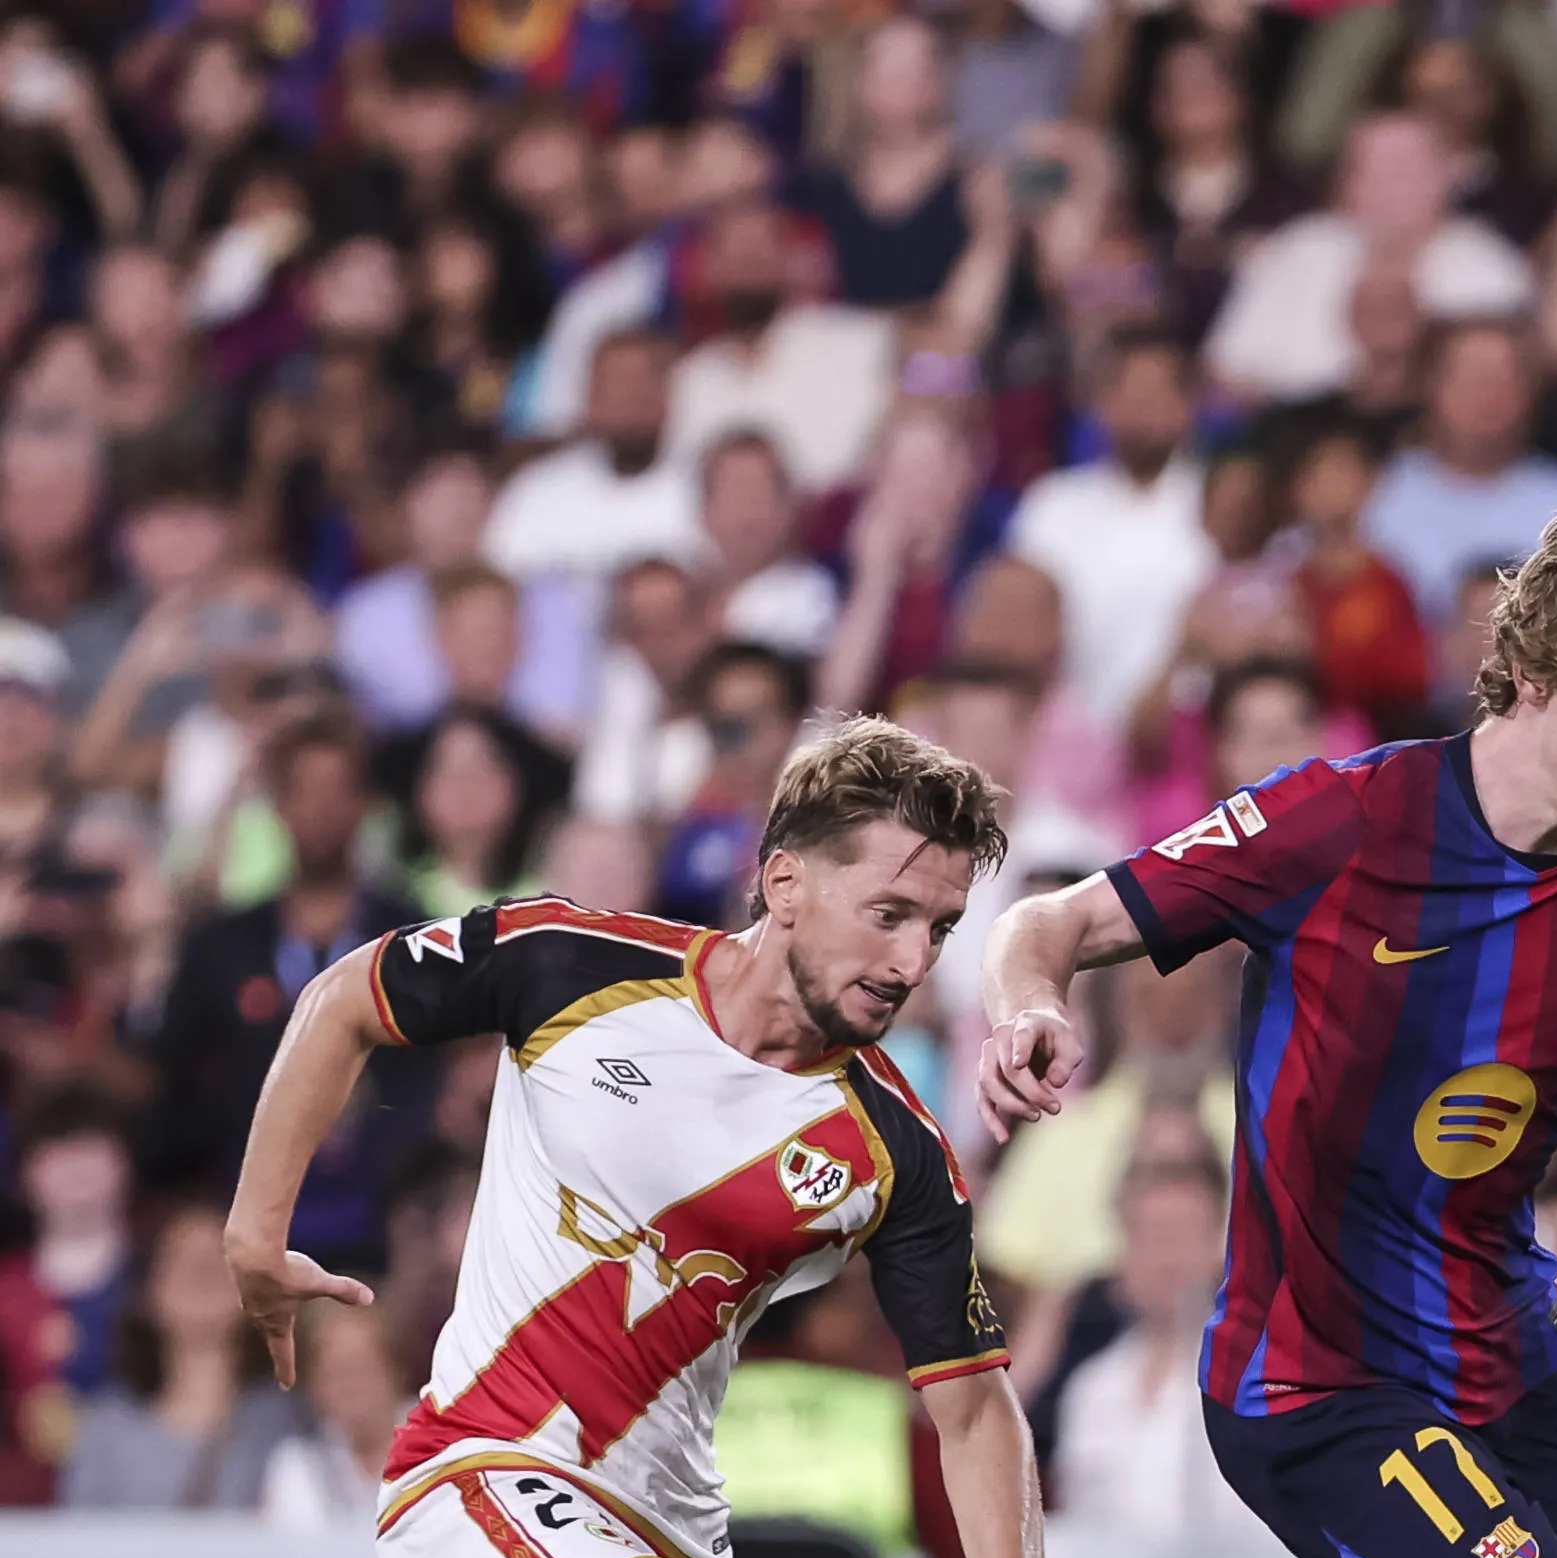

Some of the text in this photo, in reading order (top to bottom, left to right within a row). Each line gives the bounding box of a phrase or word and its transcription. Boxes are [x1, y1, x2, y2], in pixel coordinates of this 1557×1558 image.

[591, 1077, 638, 1105] umbro
[515, 1477, 611, 1530] 2
[1379, 1426, 1505, 1544] 17
